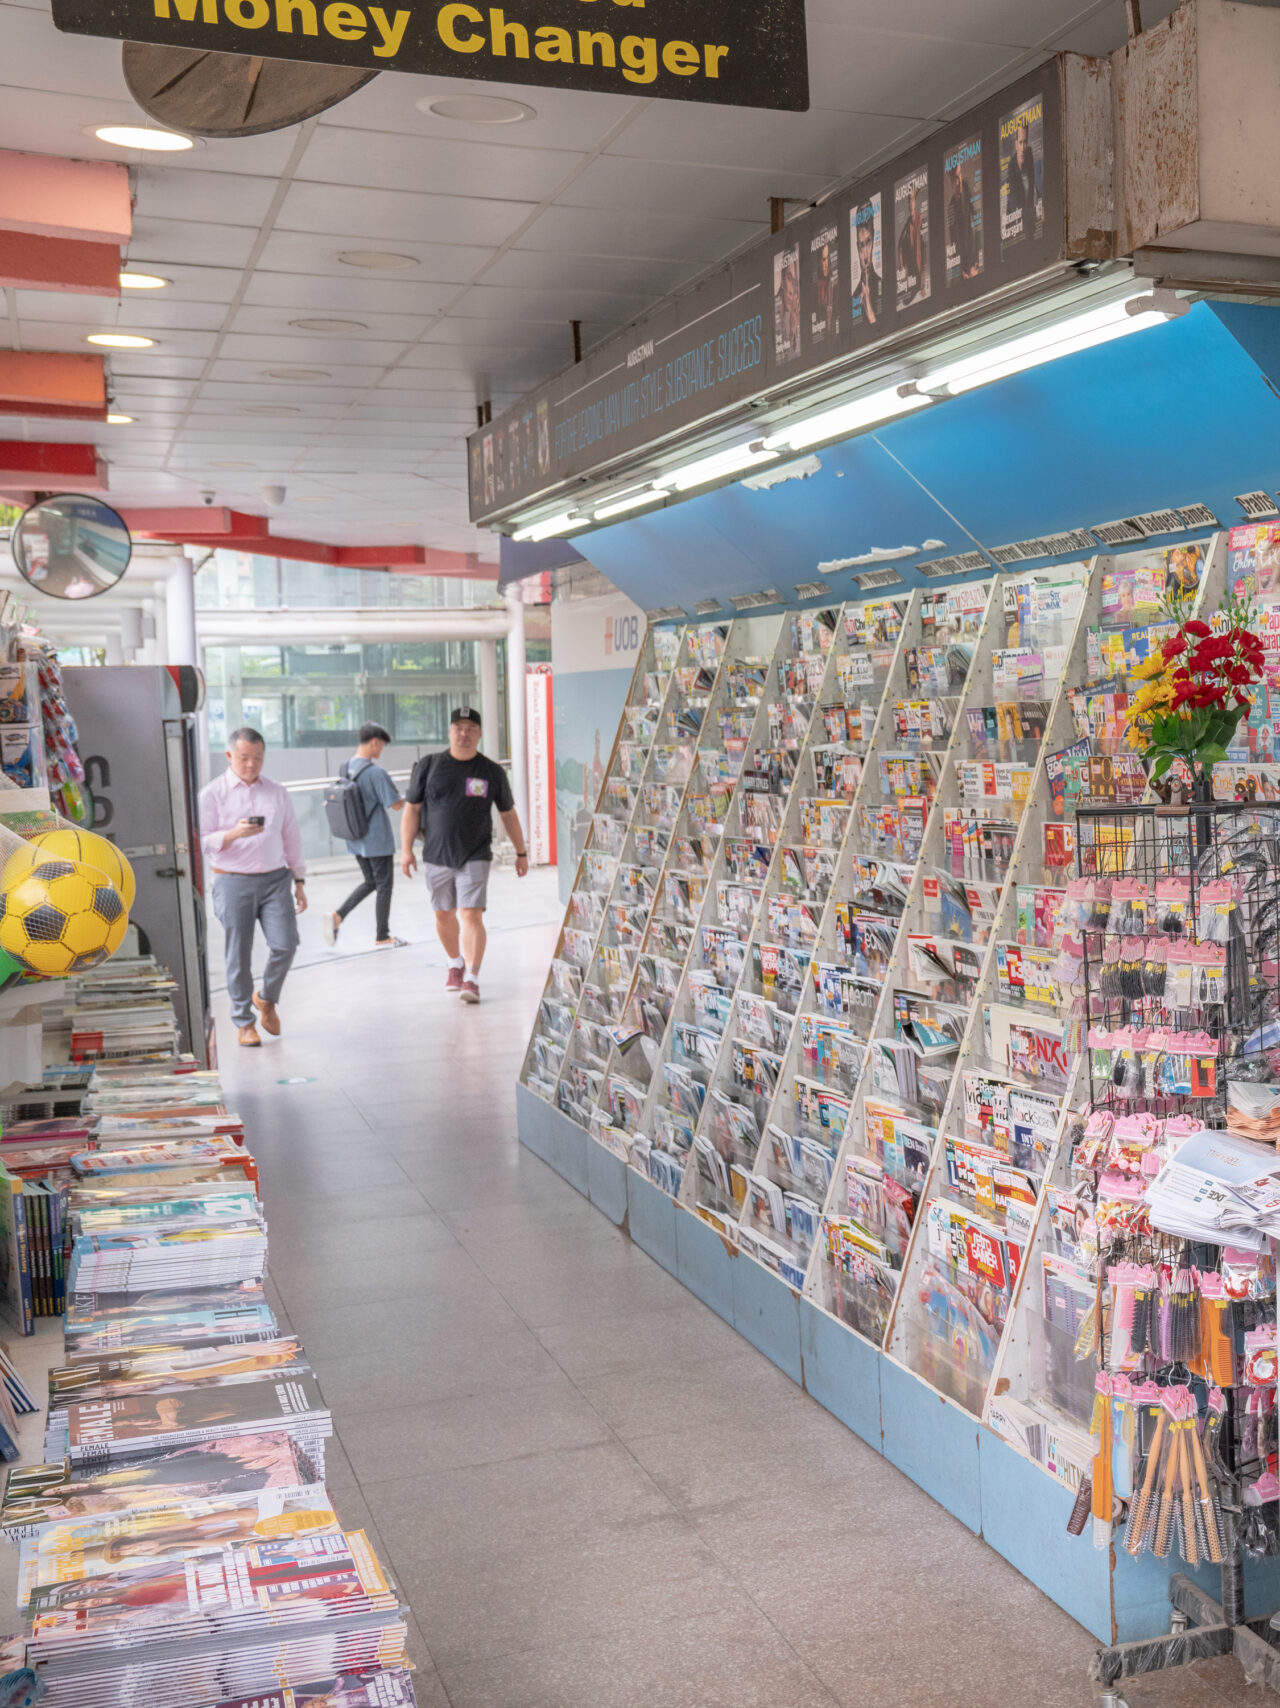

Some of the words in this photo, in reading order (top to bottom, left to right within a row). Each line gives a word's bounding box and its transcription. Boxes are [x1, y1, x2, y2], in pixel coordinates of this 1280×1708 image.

[438, 3, 729, 84] Changer
[1001, 102, 1042, 140] AUGUSTMAN
[944, 139, 981, 173] AUGUSTMAN
[895, 171, 928, 203] AUGUSTMAN
[811, 225, 838, 253] AUGUSTMAN
[626, 340, 655, 368] AUGUSTMAN
[718, 314, 762, 380] SUCCESS
[1176, 504, 1212, 525] Games
[1238, 492, 1275, 512] Crafts
[1140, 509, 1182, 532] Gadgets
[615, 616, 638, 651] UOB
[971, 1232, 992, 1253] retro
[19, 1244, 28, 1273] Directory
[971, 1246, 998, 1271] GAMER
[80, 1442, 109, 1452] FEMALE
[1, 1462, 69, 1528] VOGUE
[3, 1524, 37, 1537] VOGUE
